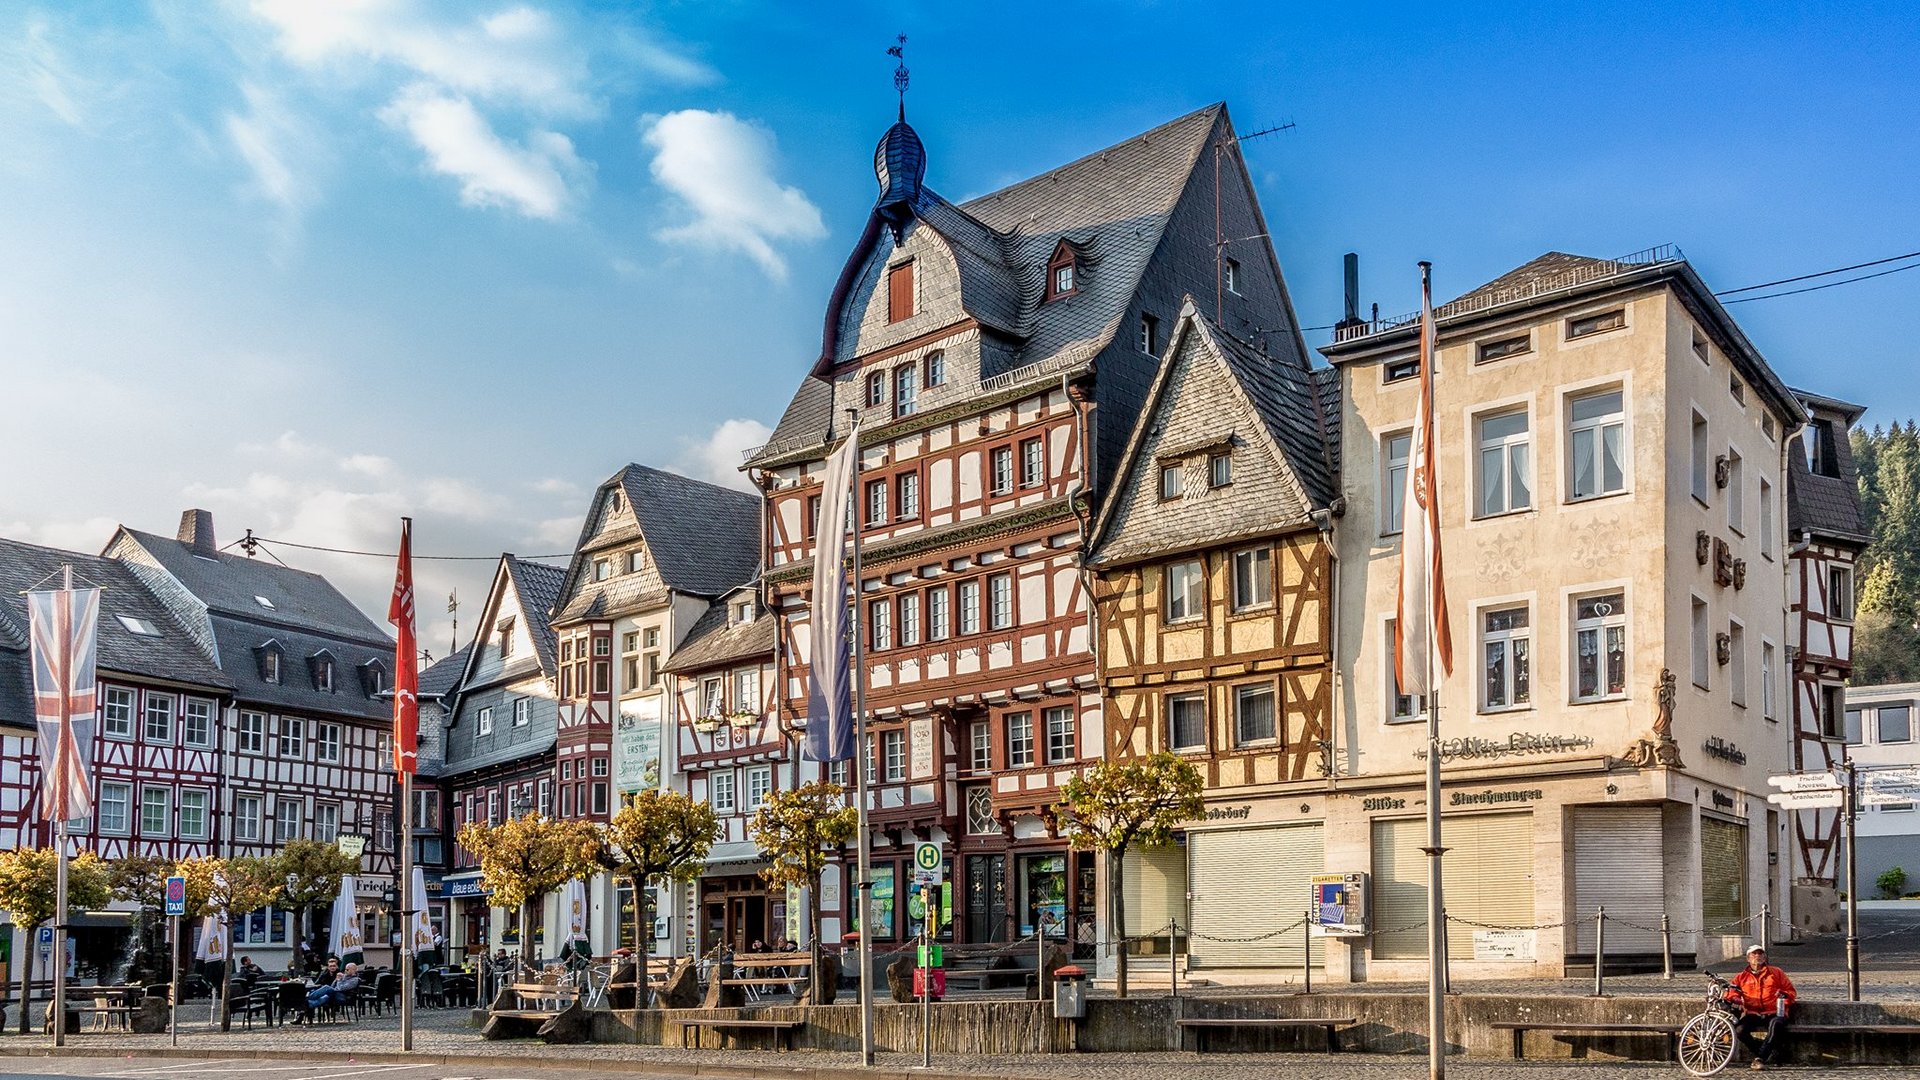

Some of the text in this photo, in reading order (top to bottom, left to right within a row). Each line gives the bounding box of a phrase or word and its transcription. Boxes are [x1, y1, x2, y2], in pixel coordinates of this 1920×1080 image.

[627, 744, 649, 755] ERSTEN
[1792, 793, 1834, 801] Krankenhaus
[1363, 797, 1406, 811] Bilder
[923, 849, 934, 864] H
[452, 883, 467, 895] blaue
[168, 902, 183, 911] TAXI
[42, 930, 51, 941] P
